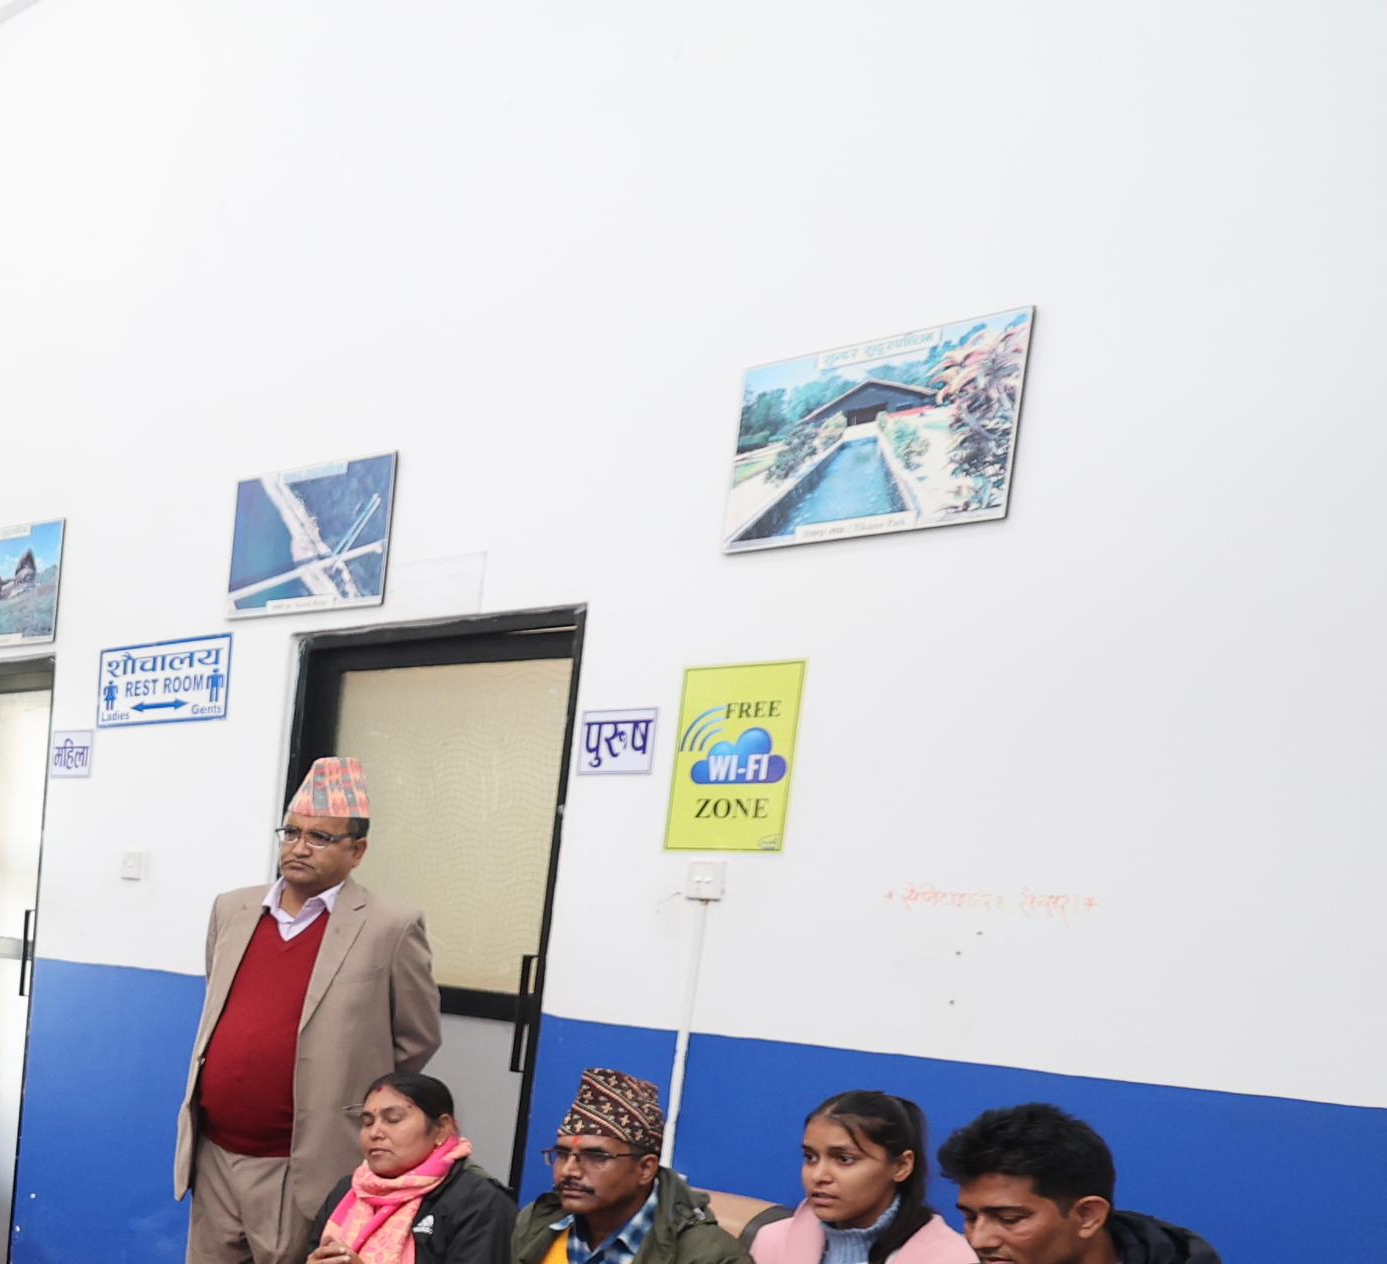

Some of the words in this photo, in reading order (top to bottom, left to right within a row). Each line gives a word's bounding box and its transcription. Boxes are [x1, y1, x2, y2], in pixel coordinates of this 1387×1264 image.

[107, 648, 223, 677] शौचालय
[126, 679, 159, 697] REST
[164, 674, 204, 693] ROOM
[102, 711, 130, 721] Ladies
[191, 703, 223, 714] Gents
[725, 700, 782, 719] FREE
[54, 738, 89, 769] महिला
[708, 754, 770, 781] WI-FI
[695, 798, 769, 819] ZONE
